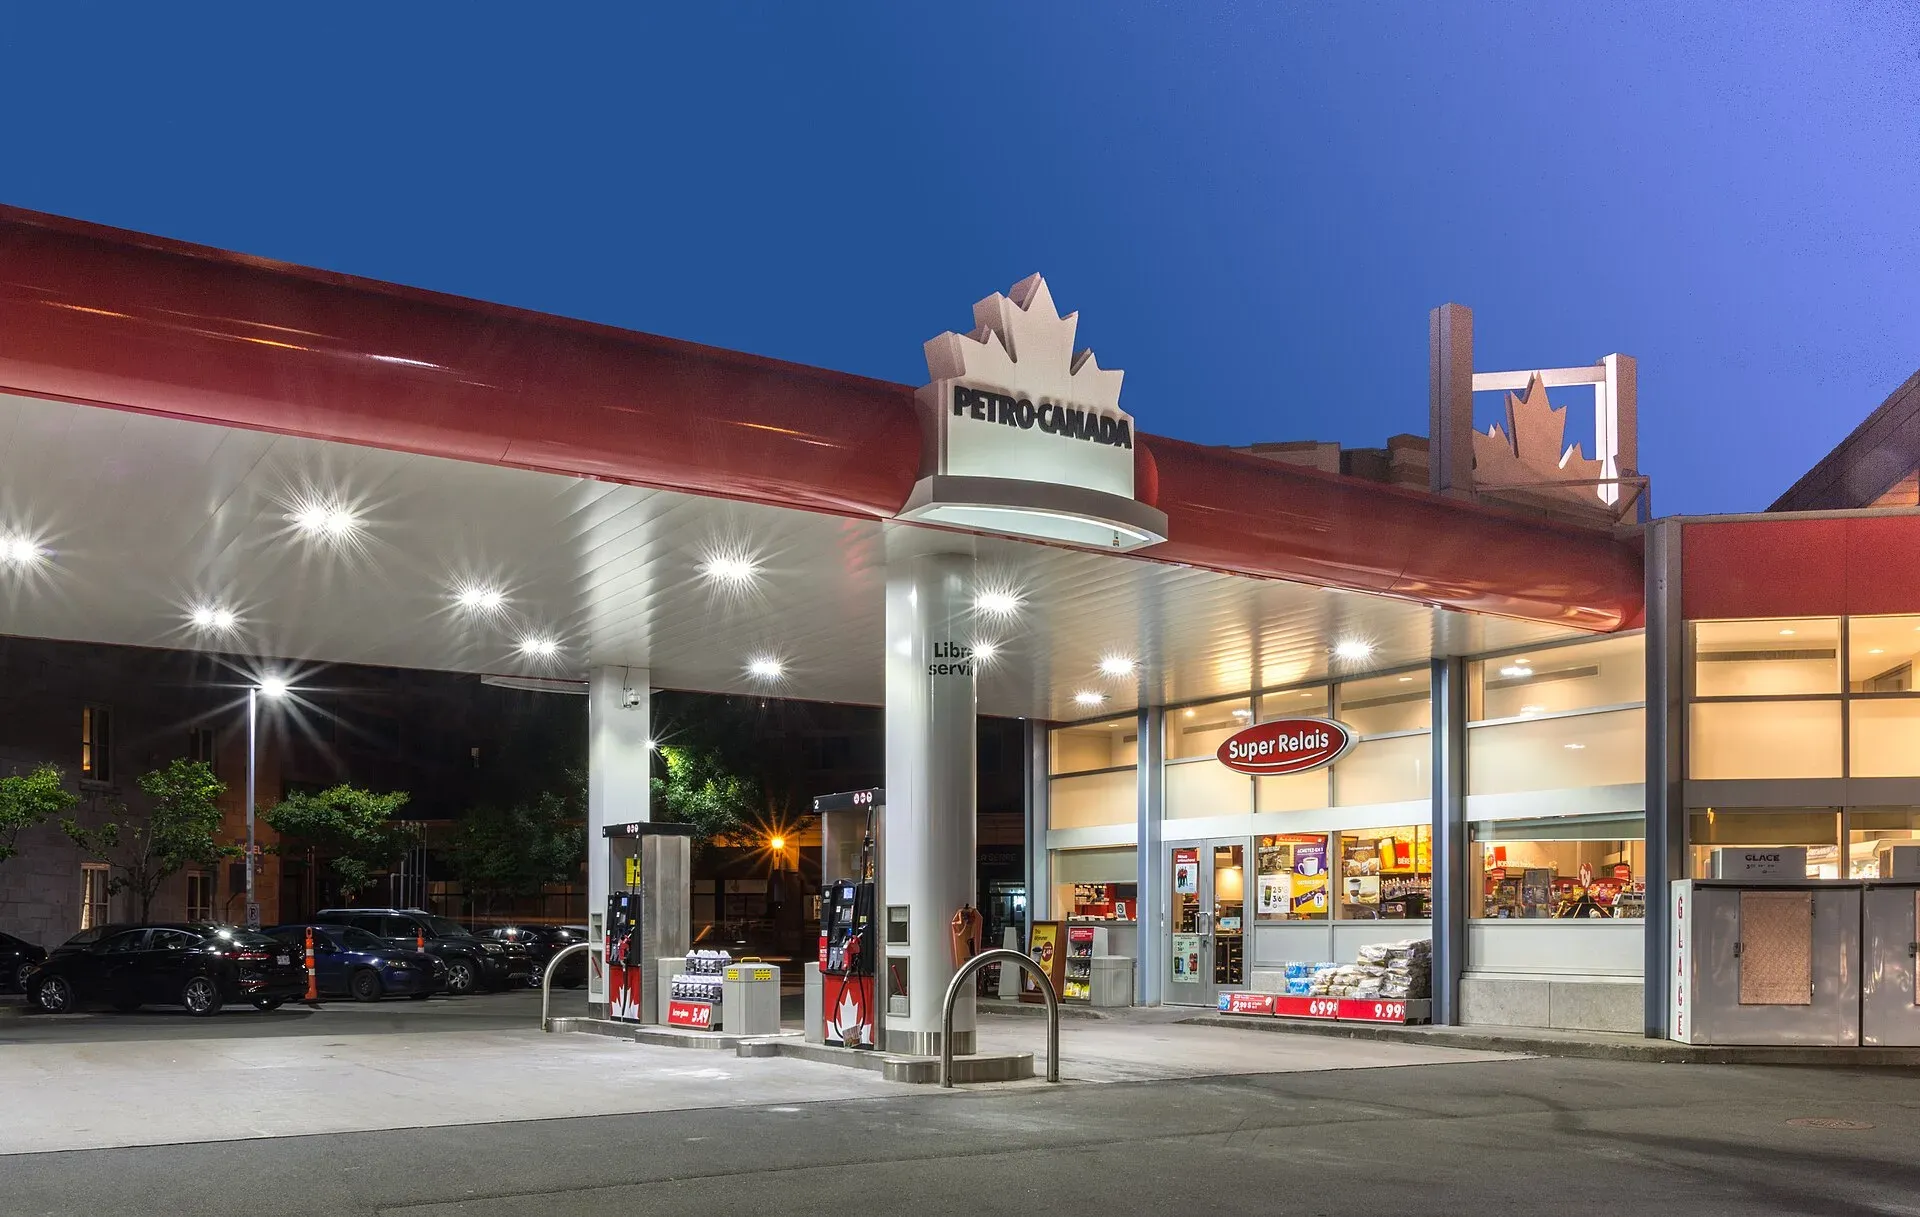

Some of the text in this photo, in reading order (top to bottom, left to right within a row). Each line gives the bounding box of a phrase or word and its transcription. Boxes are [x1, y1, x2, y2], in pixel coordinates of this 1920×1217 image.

[953, 385, 1133, 450] PETRO-CANADA
[928, 660, 974, 676] servi
[1229, 729, 1329, 762] Super Relais
